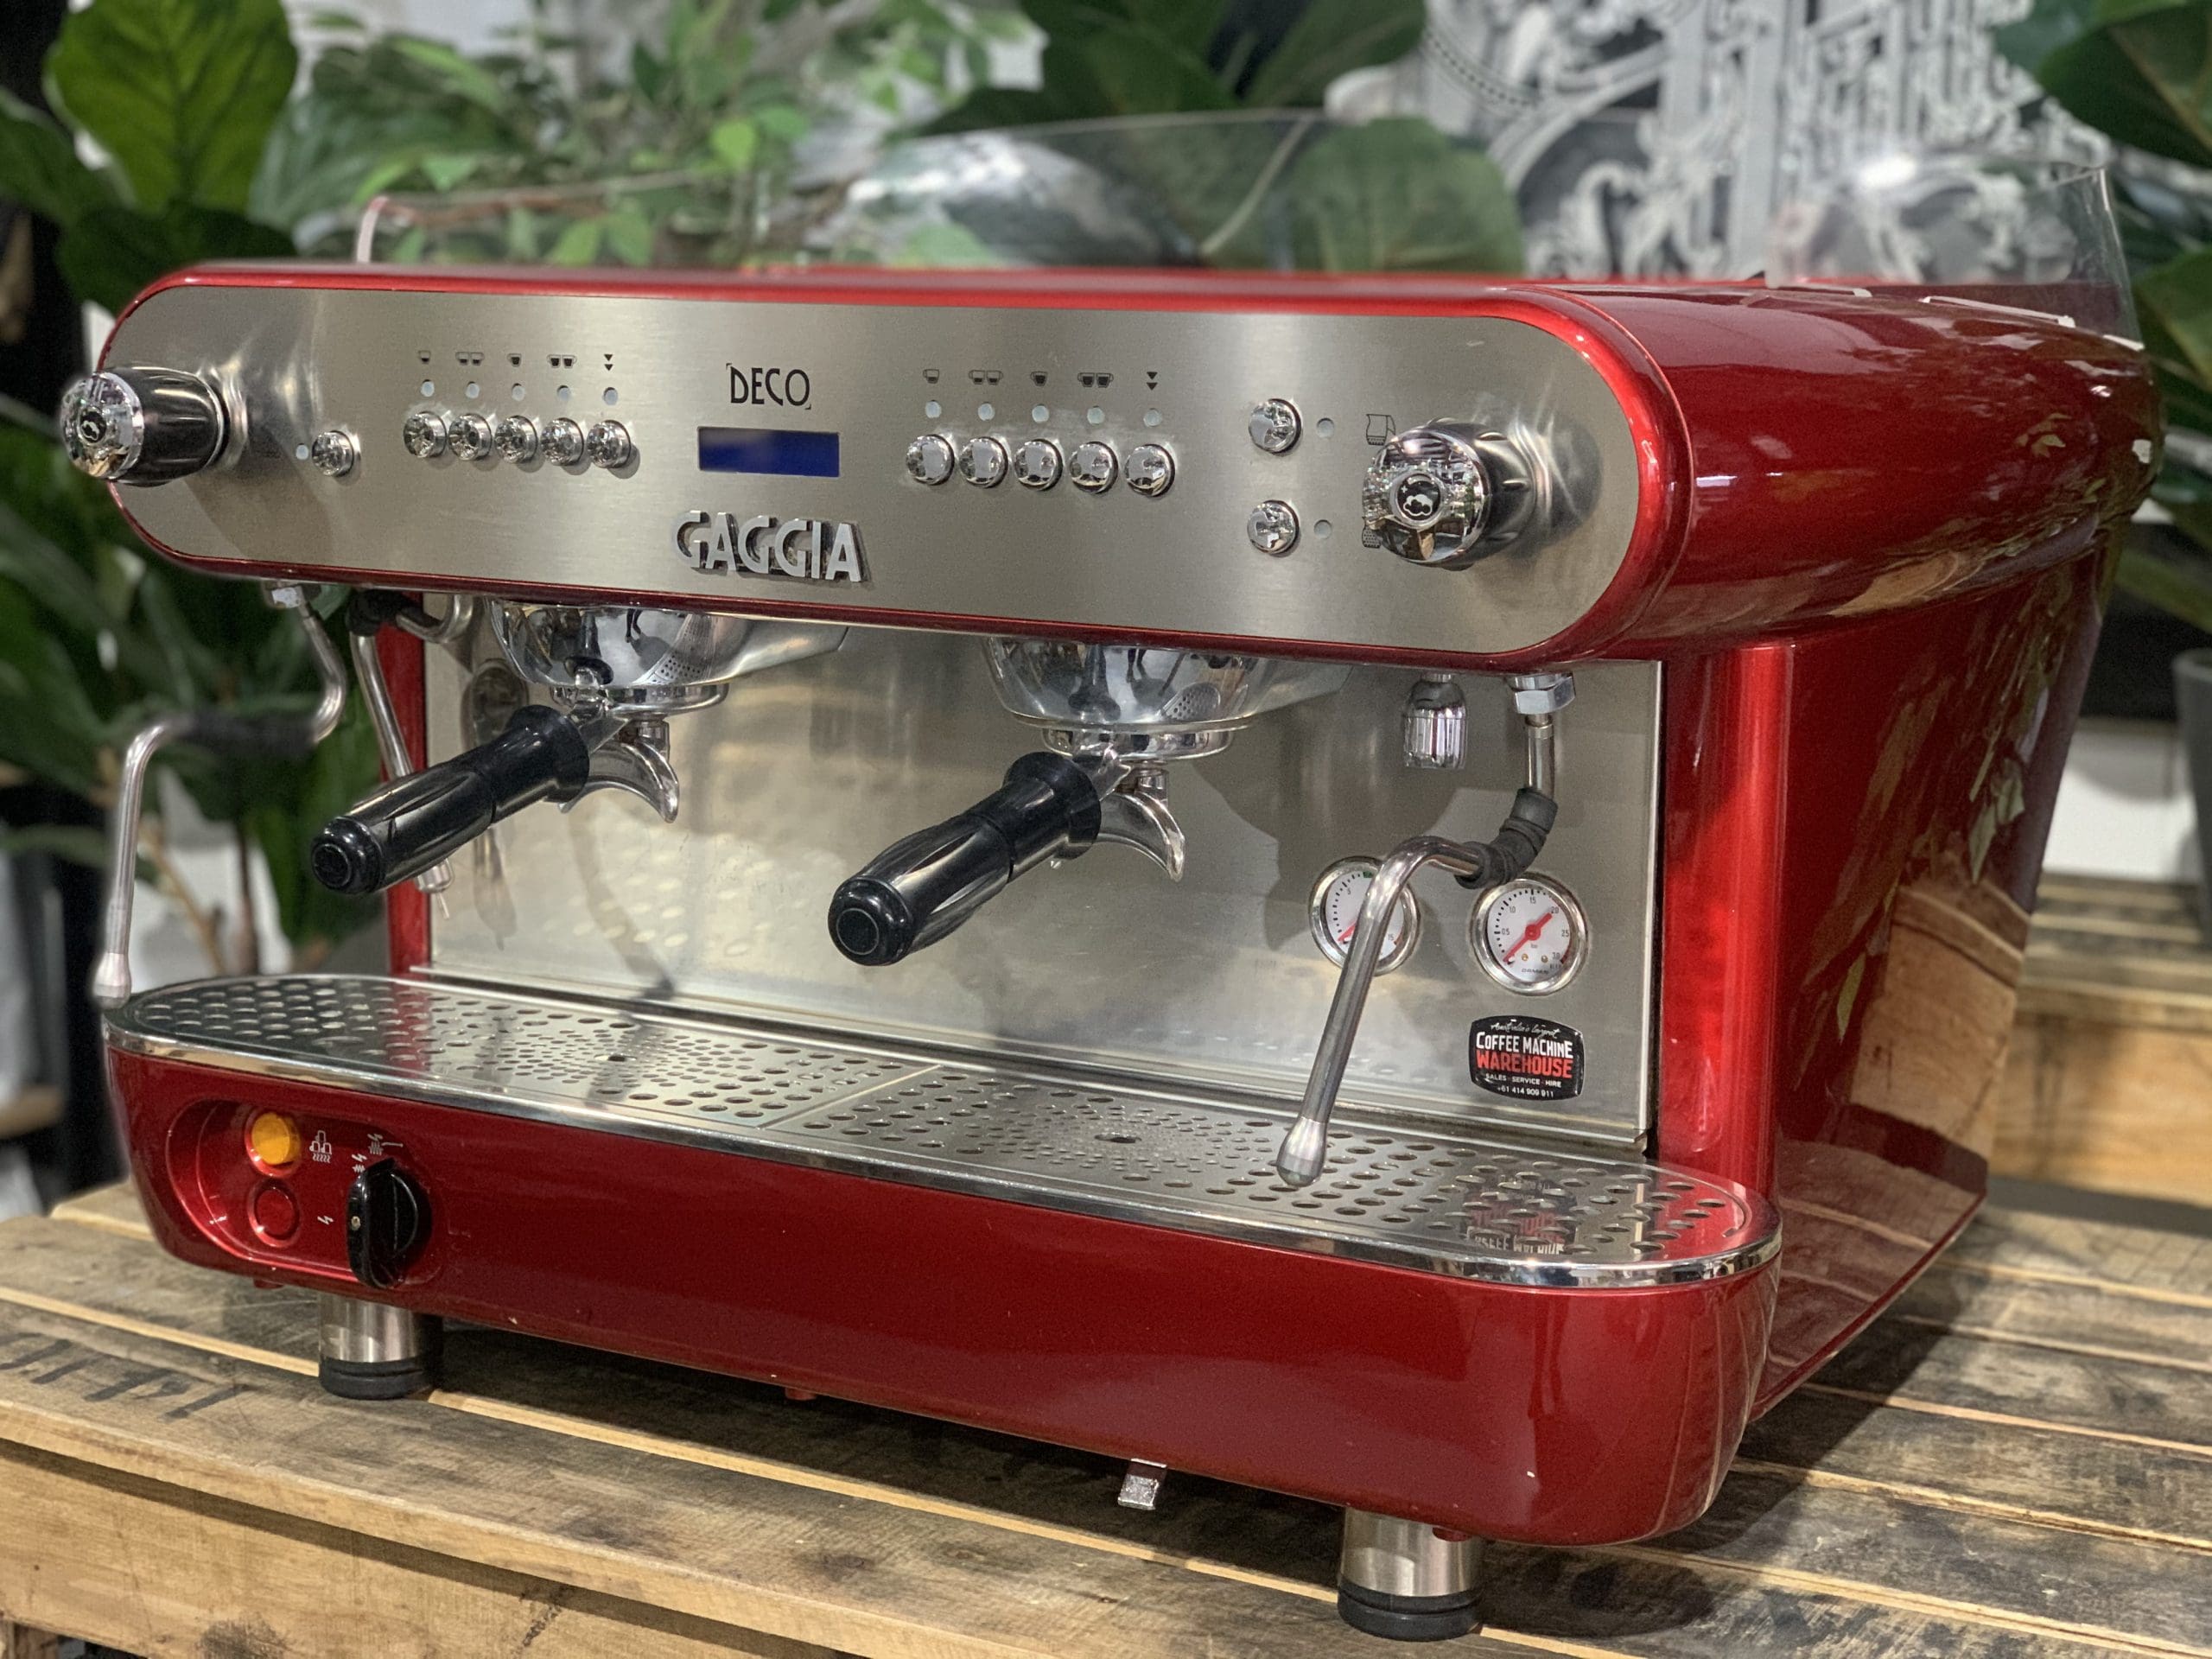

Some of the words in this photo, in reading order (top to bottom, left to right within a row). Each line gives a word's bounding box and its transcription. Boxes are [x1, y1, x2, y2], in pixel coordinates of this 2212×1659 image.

[729, 366, 810, 406] DECO
[671, 510, 865, 583] GAGGIA
[1476, 1032, 1520, 1053] COFFEE
[1522, 1036, 1573, 1058] MACHINE
[1476, 1050, 1573, 1078] WAREHOUSE
[1512, 1076, 1541, 1085] SERVICE
[1512, 1086, 1525, 1095] 414
